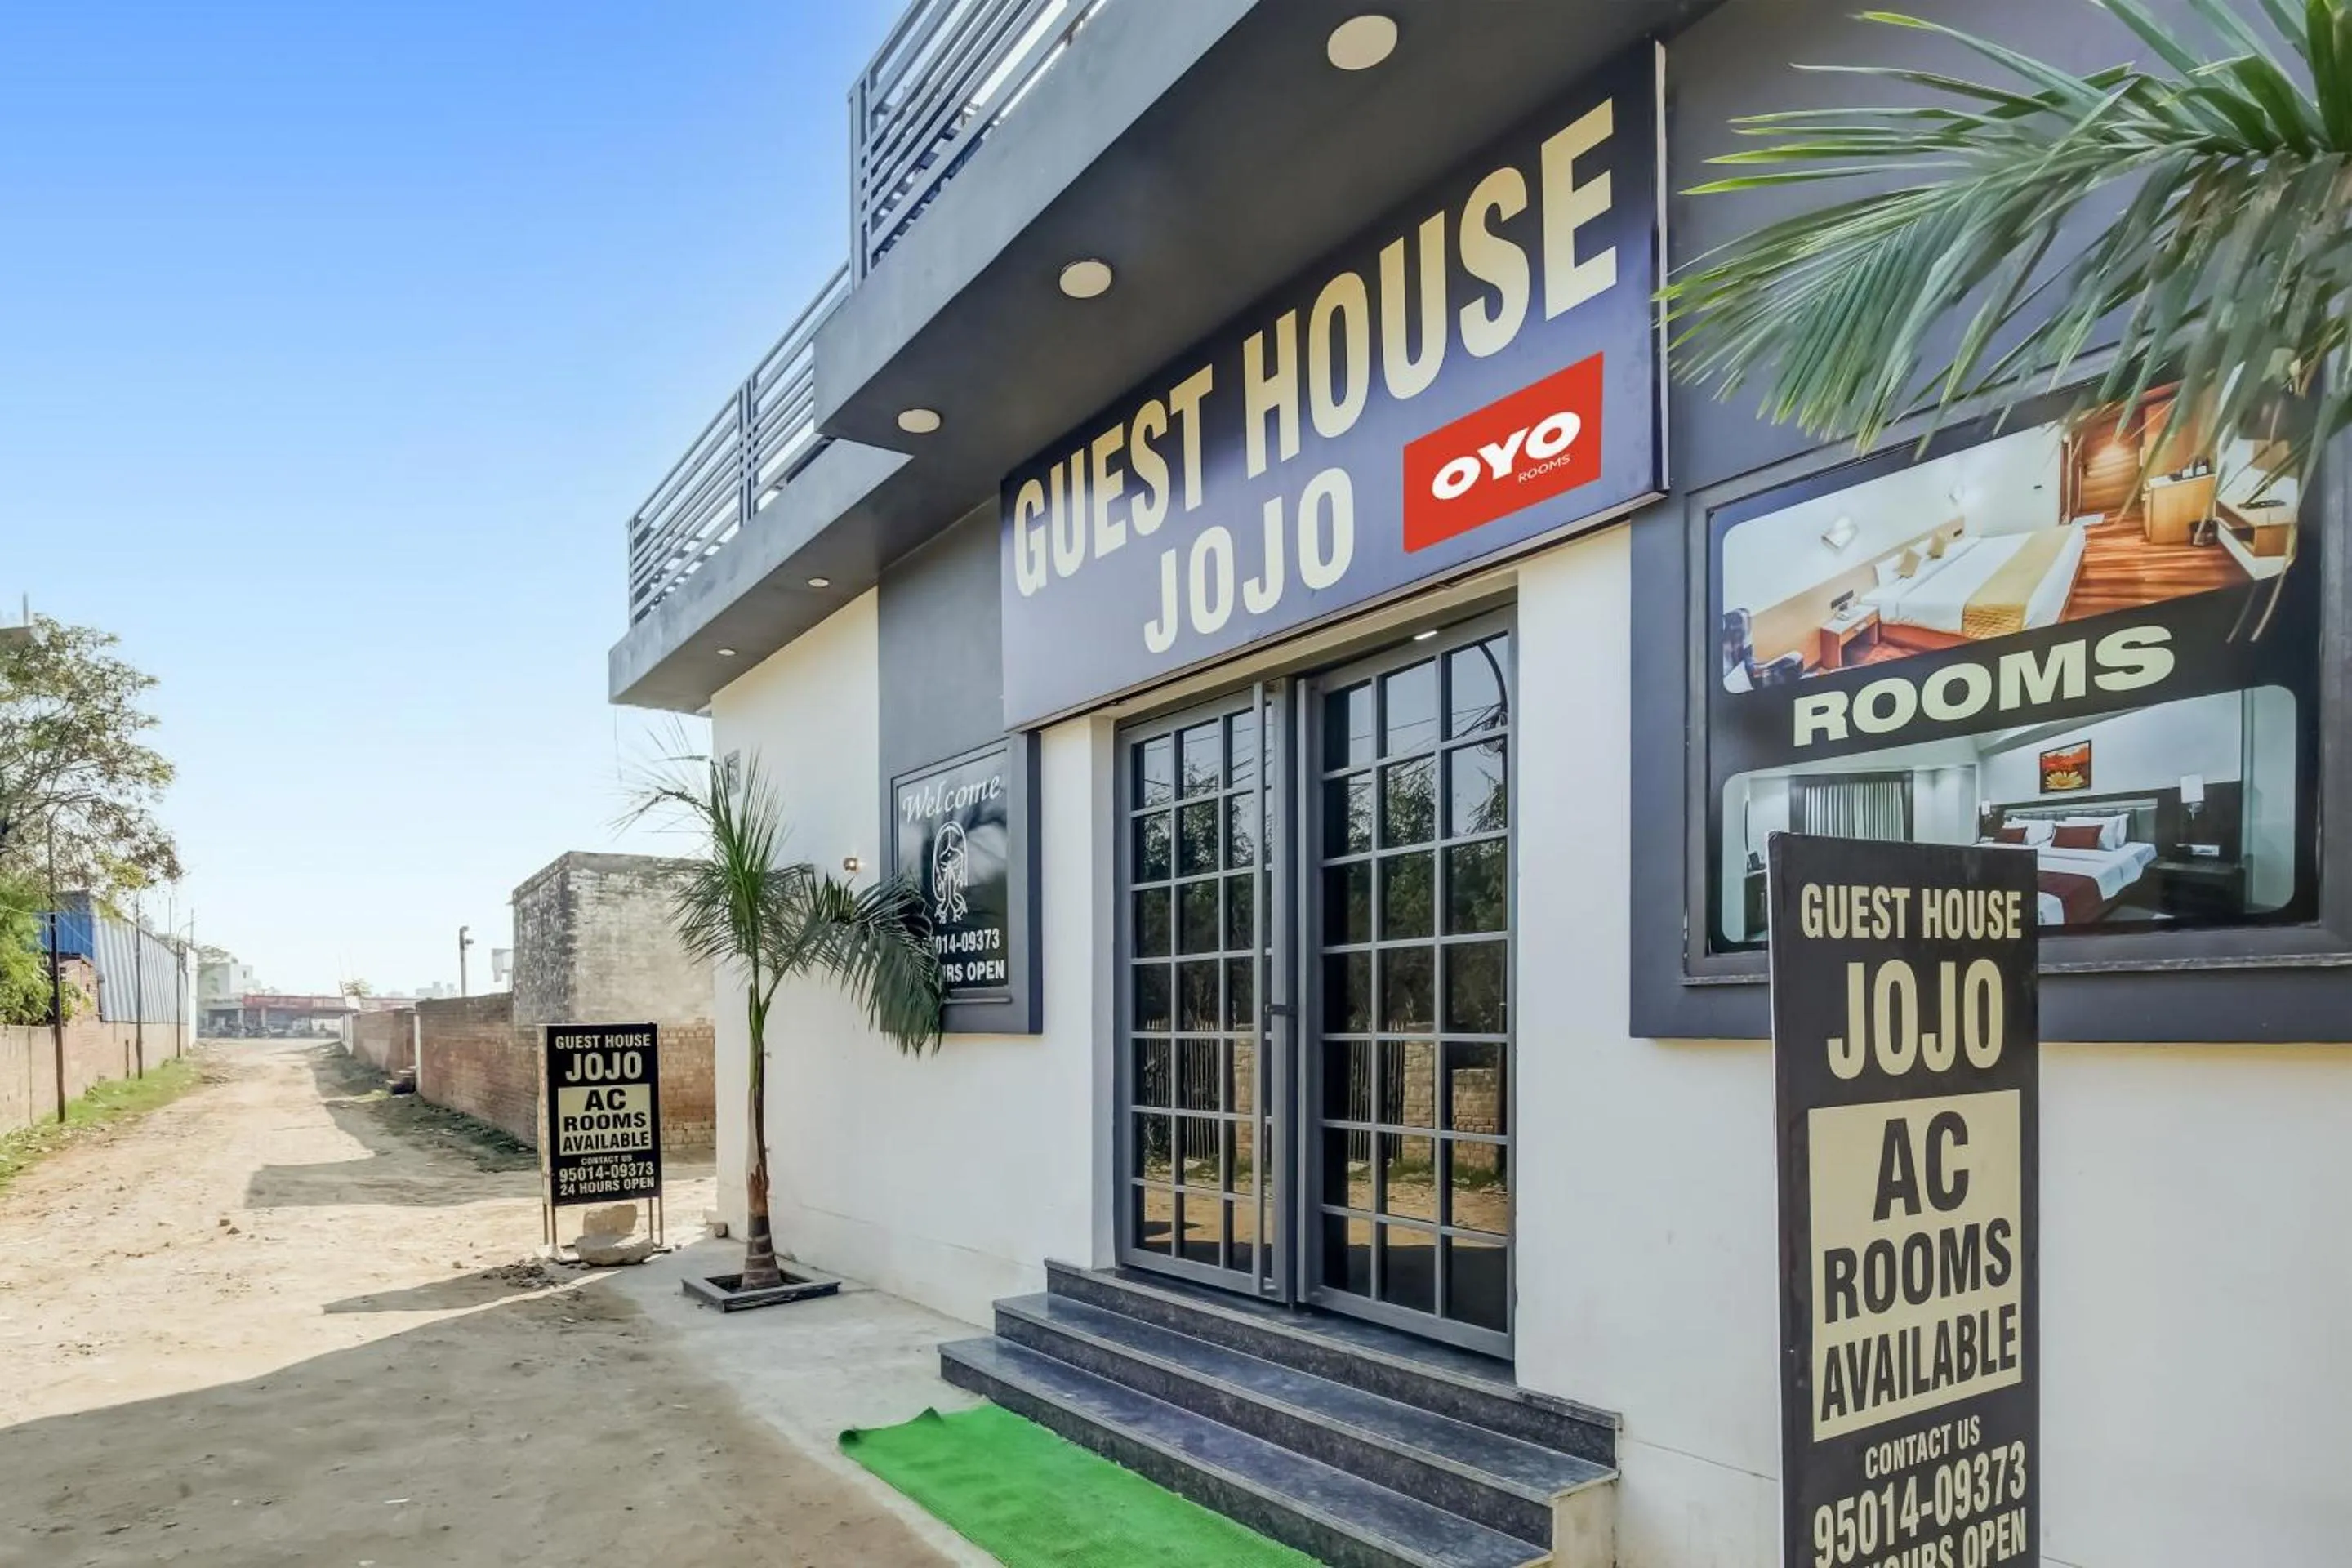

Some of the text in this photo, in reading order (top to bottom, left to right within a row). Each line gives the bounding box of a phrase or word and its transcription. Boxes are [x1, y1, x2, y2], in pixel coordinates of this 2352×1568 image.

[1013, 97, 1617, 598] GUEST HOUSE
[1432, 411, 1582, 500] OYO
[1518, 454, 1570, 483] ROOMS
[1143, 467, 1355, 653] JOJO
[1793, 625, 2176, 747] ROOMS
[902, 775, 1000, 823] Welcome
[1801, 883, 2022, 940] GUEST HOUSE
[924, 928, 1000, 954] 014-09373
[967, 960, 1004, 981] OPEN
[555, 1033, 651, 1049] GUEST HOUSE
[1827, 959, 2003, 1080] JOJO
[565, 1051, 642, 1081] JOJO
[564, 1111, 646, 1132] ROOMS
[584, 1089, 626, 1111] AC
[563, 1131, 649, 1152] AVAILABLE
[581, 1156, 619, 1165] CONTACT
[1873, 1111, 1969, 1221] AC
[559, 1161, 654, 1183] 95014-09373
[559, 1177, 654, 1196] 24 HOURS OPEN
[1824, 1218, 2011, 1324] ROOMS
[1820, 1303, 2016, 1422] AVAILABLE
[1865, 1415, 1980, 1479] CONTACT US
[1814, 1441, 2026, 1568] 95014-09373
[1962, 1507, 2026, 1568] OPEN
